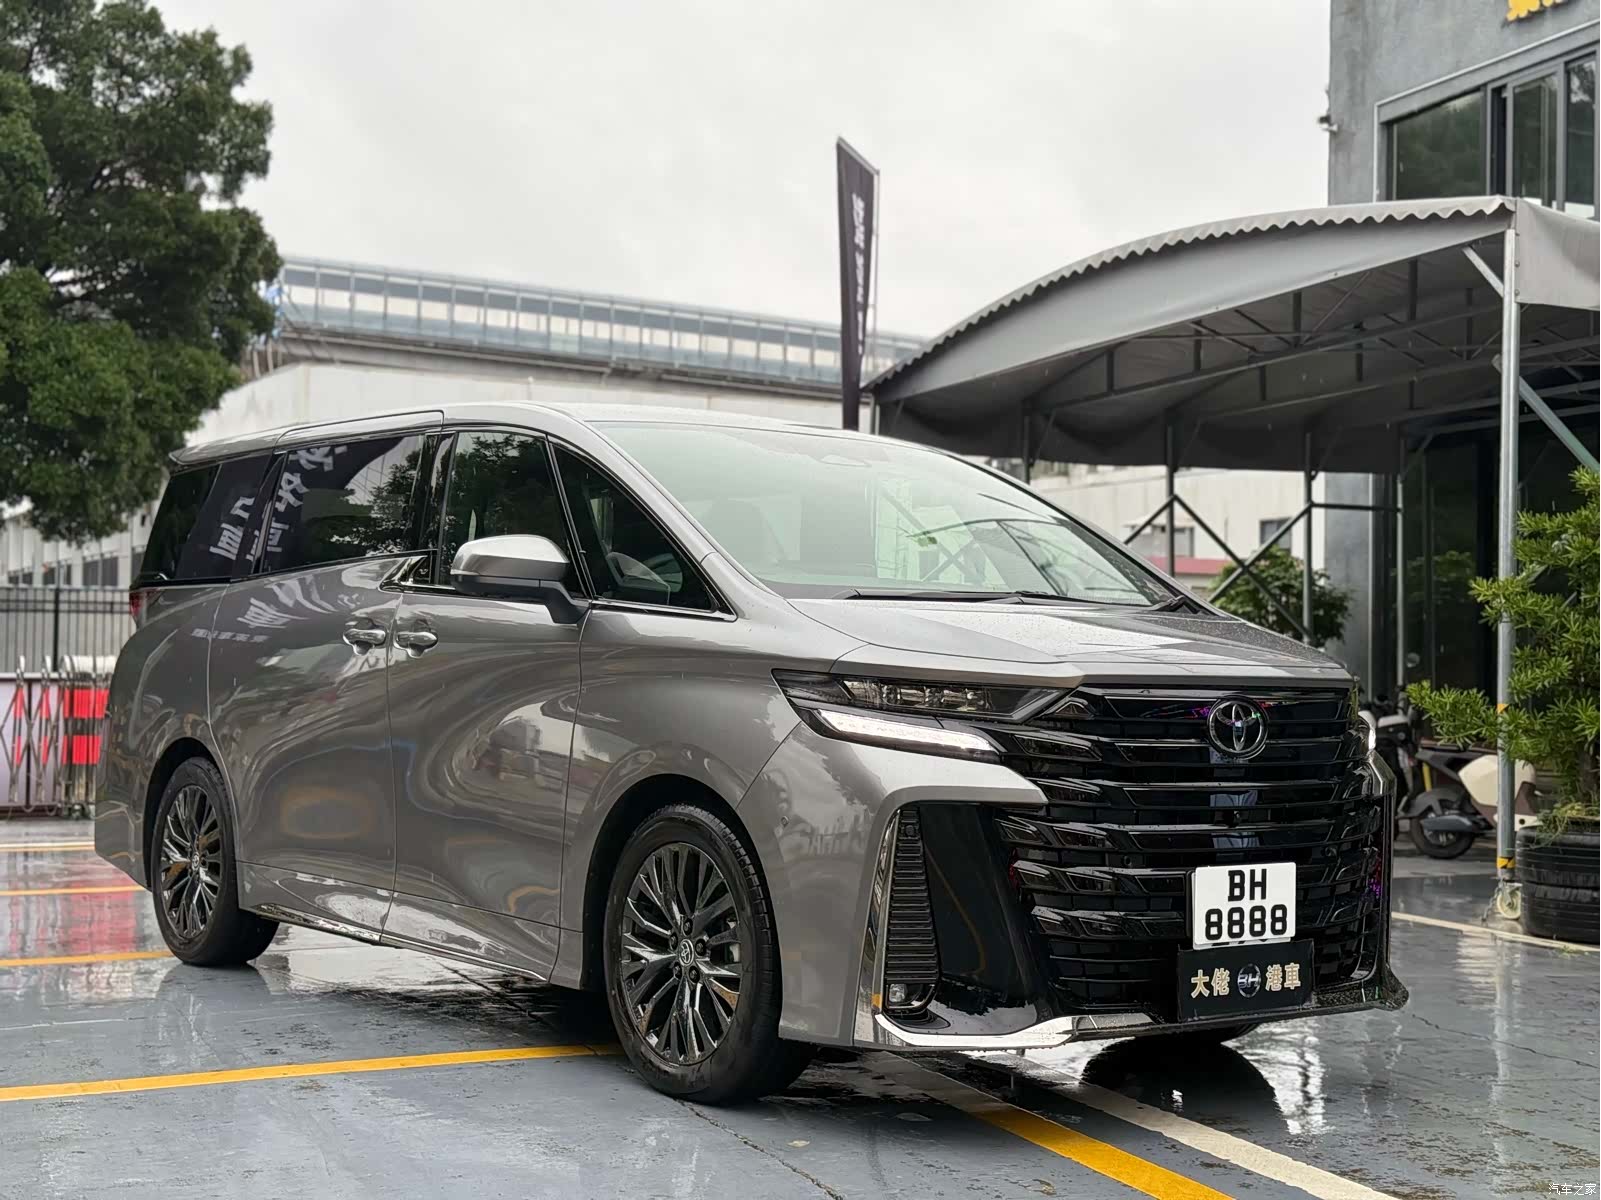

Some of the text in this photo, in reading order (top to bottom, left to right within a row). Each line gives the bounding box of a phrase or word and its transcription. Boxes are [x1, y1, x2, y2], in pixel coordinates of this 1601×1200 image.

[1228, 868, 1267, 902] BH
[1205, 904, 1288, 941] 8888
[1191, 962, 1301, 998] 大佬 BH 港車
